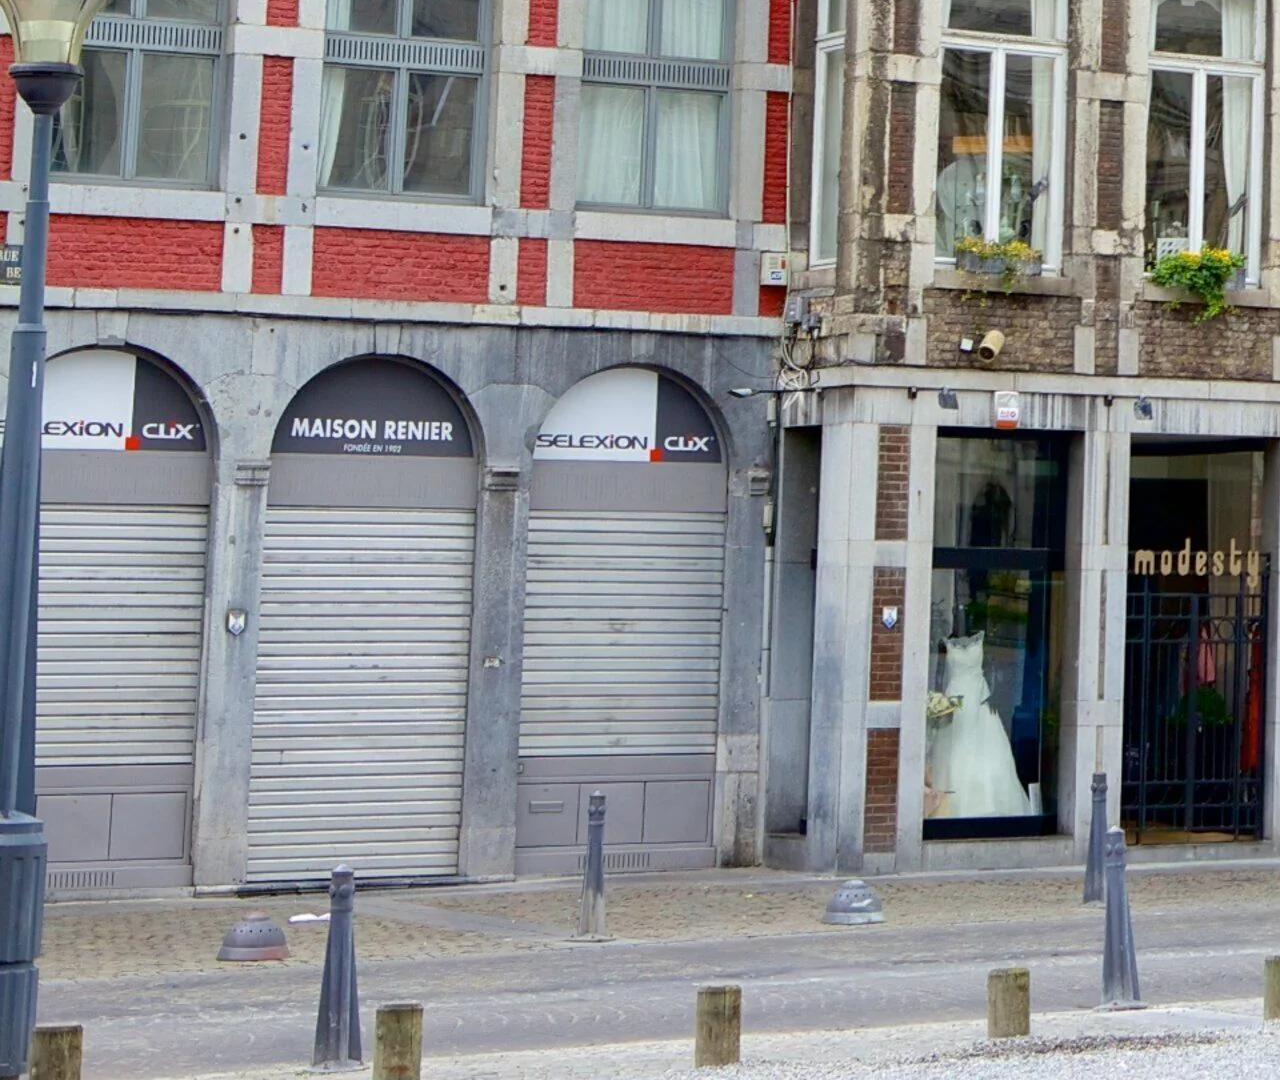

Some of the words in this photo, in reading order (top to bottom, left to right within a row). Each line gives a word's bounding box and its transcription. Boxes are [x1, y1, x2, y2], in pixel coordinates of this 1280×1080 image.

[291, 418, 376, 439] MAISON
[384, 420, 453, 441] RENIER
[343, 443, 371, 452] FONDÉE
[372, 444, 383, 452] EN
[1134, 538, 1261, 587] modesty
